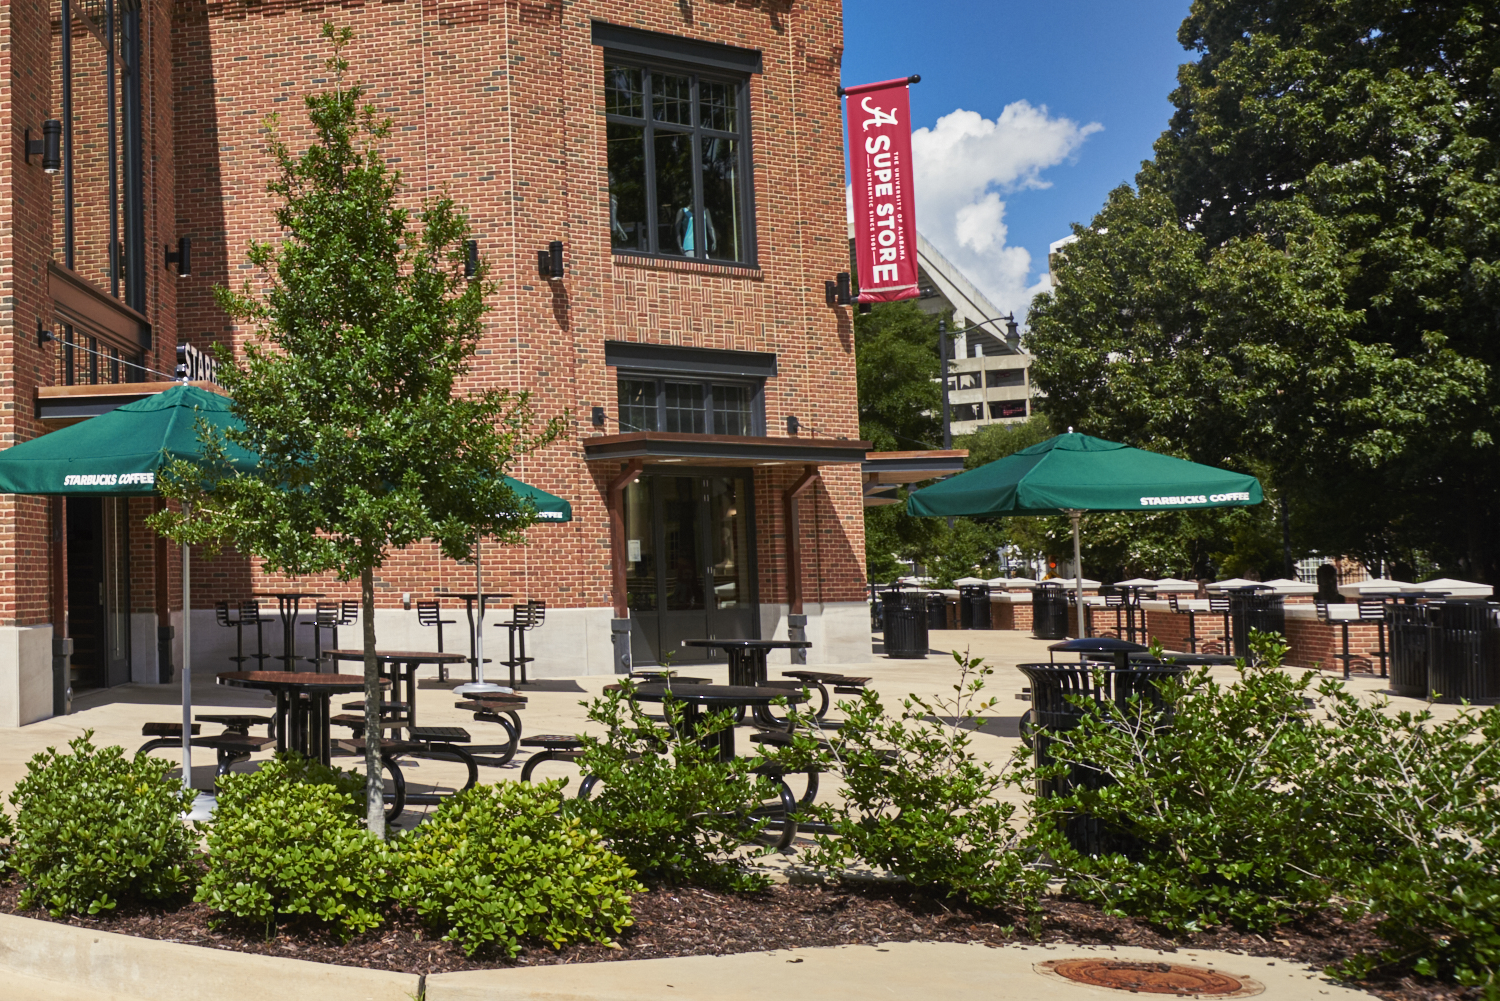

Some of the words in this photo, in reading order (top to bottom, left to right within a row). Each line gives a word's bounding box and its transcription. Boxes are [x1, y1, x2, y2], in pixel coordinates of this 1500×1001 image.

[865, 135, 893, 197] SUPE
[894, 168, 902, 210] UNIVERSITY
[897, 214, 902, 223] OF
[873, 203, 898, 283] STORE
[64, 474, 117, 486] STARBUCKS
[118, 473, 154, 484] COFFEE
[1140, 495, 1207, 505] STARBUCKS
[1209, 492, 1249, 502] COFFEE
